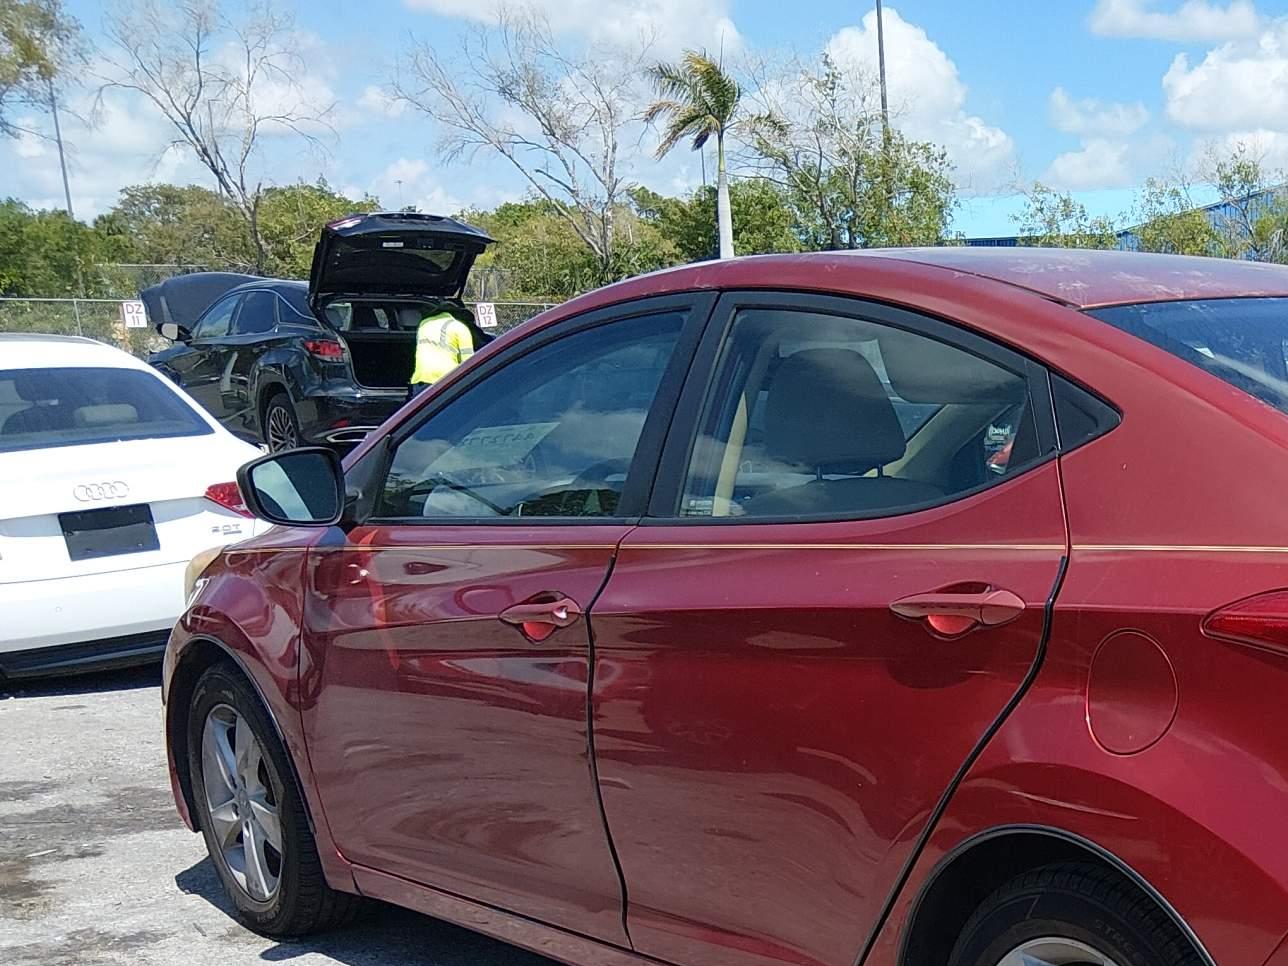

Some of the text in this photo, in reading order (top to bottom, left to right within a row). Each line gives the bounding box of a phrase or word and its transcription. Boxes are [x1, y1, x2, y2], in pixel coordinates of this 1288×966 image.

[126, 304, 143, 314] DZ
[480, 305, 493, 315] DZ
[131, 315, 140, 326] 11
[483, 316, 493, 325] 12
